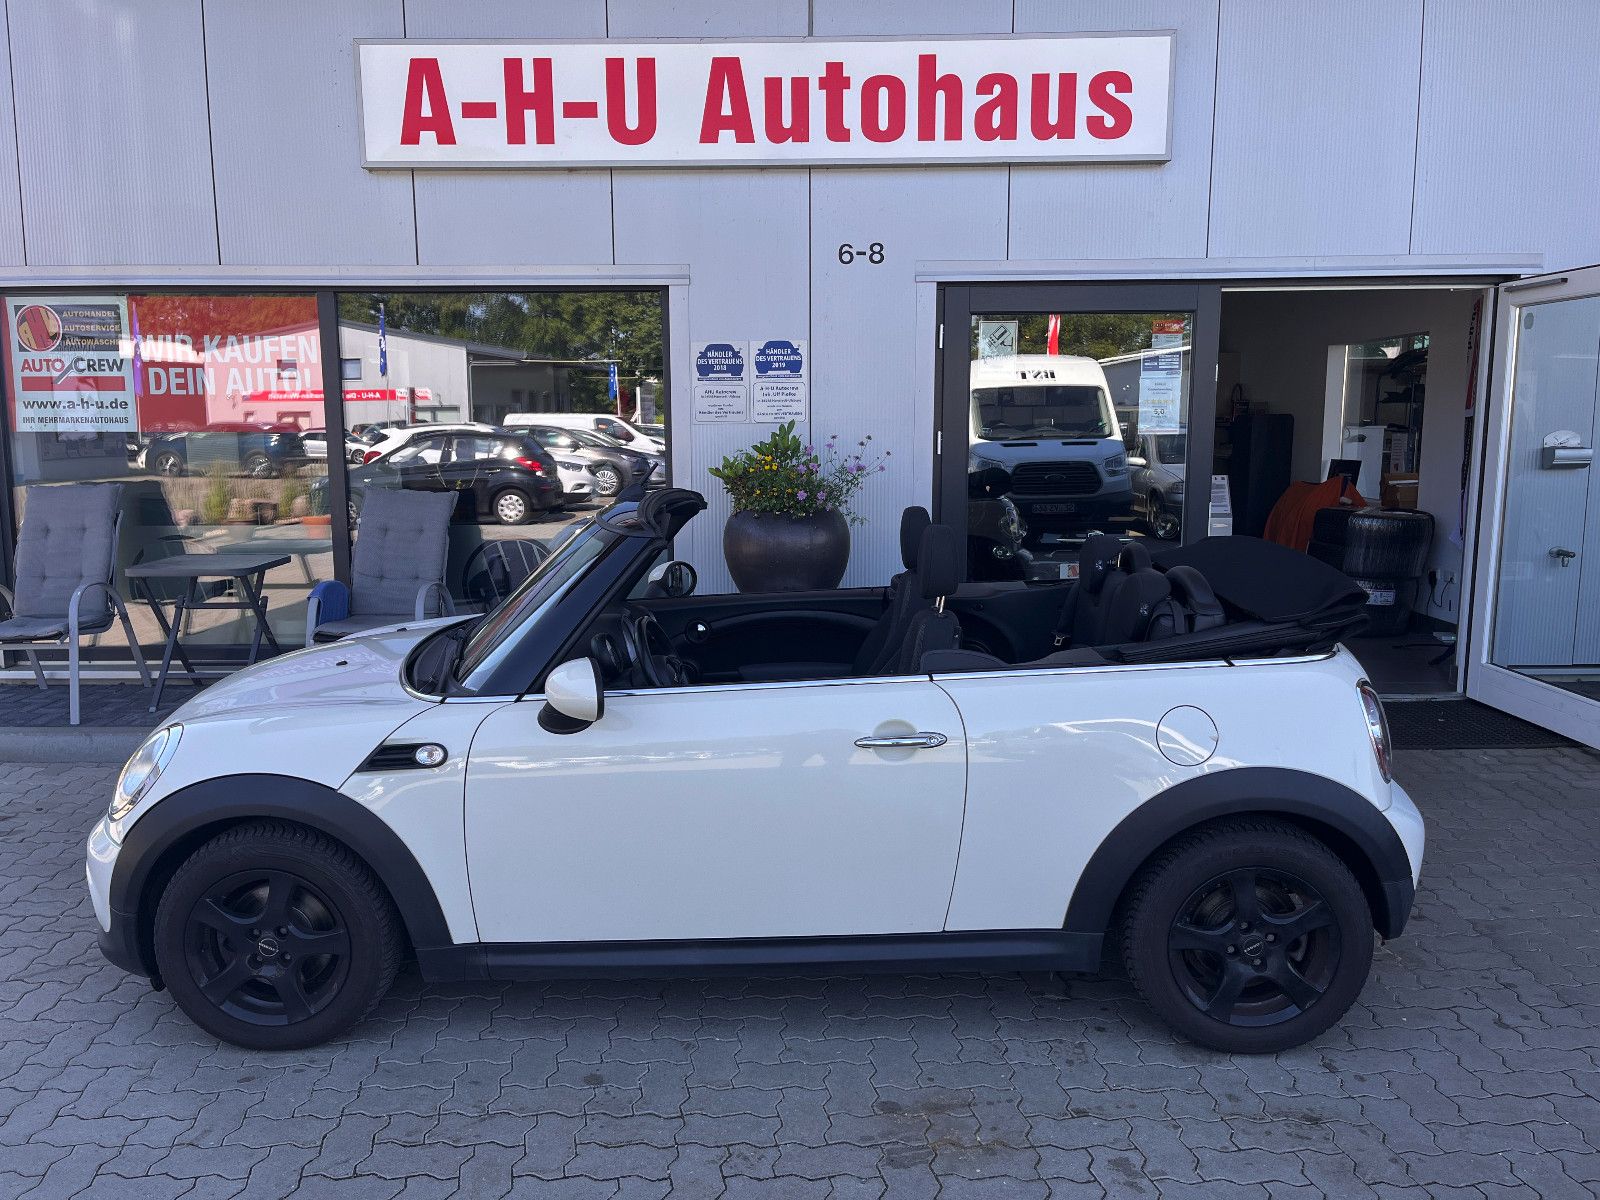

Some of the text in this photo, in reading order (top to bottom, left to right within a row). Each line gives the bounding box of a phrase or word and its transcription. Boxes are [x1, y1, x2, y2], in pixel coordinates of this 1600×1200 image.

[400, 53, 1134, 146] A-H-U Autohaus
[838, 243, 885, 266] 6-8
[63, 310, 117, 318] AUTOHANDEL
[64, 324, 121, 332] AUTOSERVICE
[139, 335, 318, 363] WIR KAUFEN
[707, 350, 733, 358] HÄNDLER
[766, 347, 792, 355] HÄNDLER
[21, 357, 124, 373] AUTO CREW
[148, 368, 312, 395] DEIN AUTO!
[23, 398, 129, 410] www.a-h-u.de
[23, 416, 129, 424] IHR MEHRMARKENAUTOHAUS
